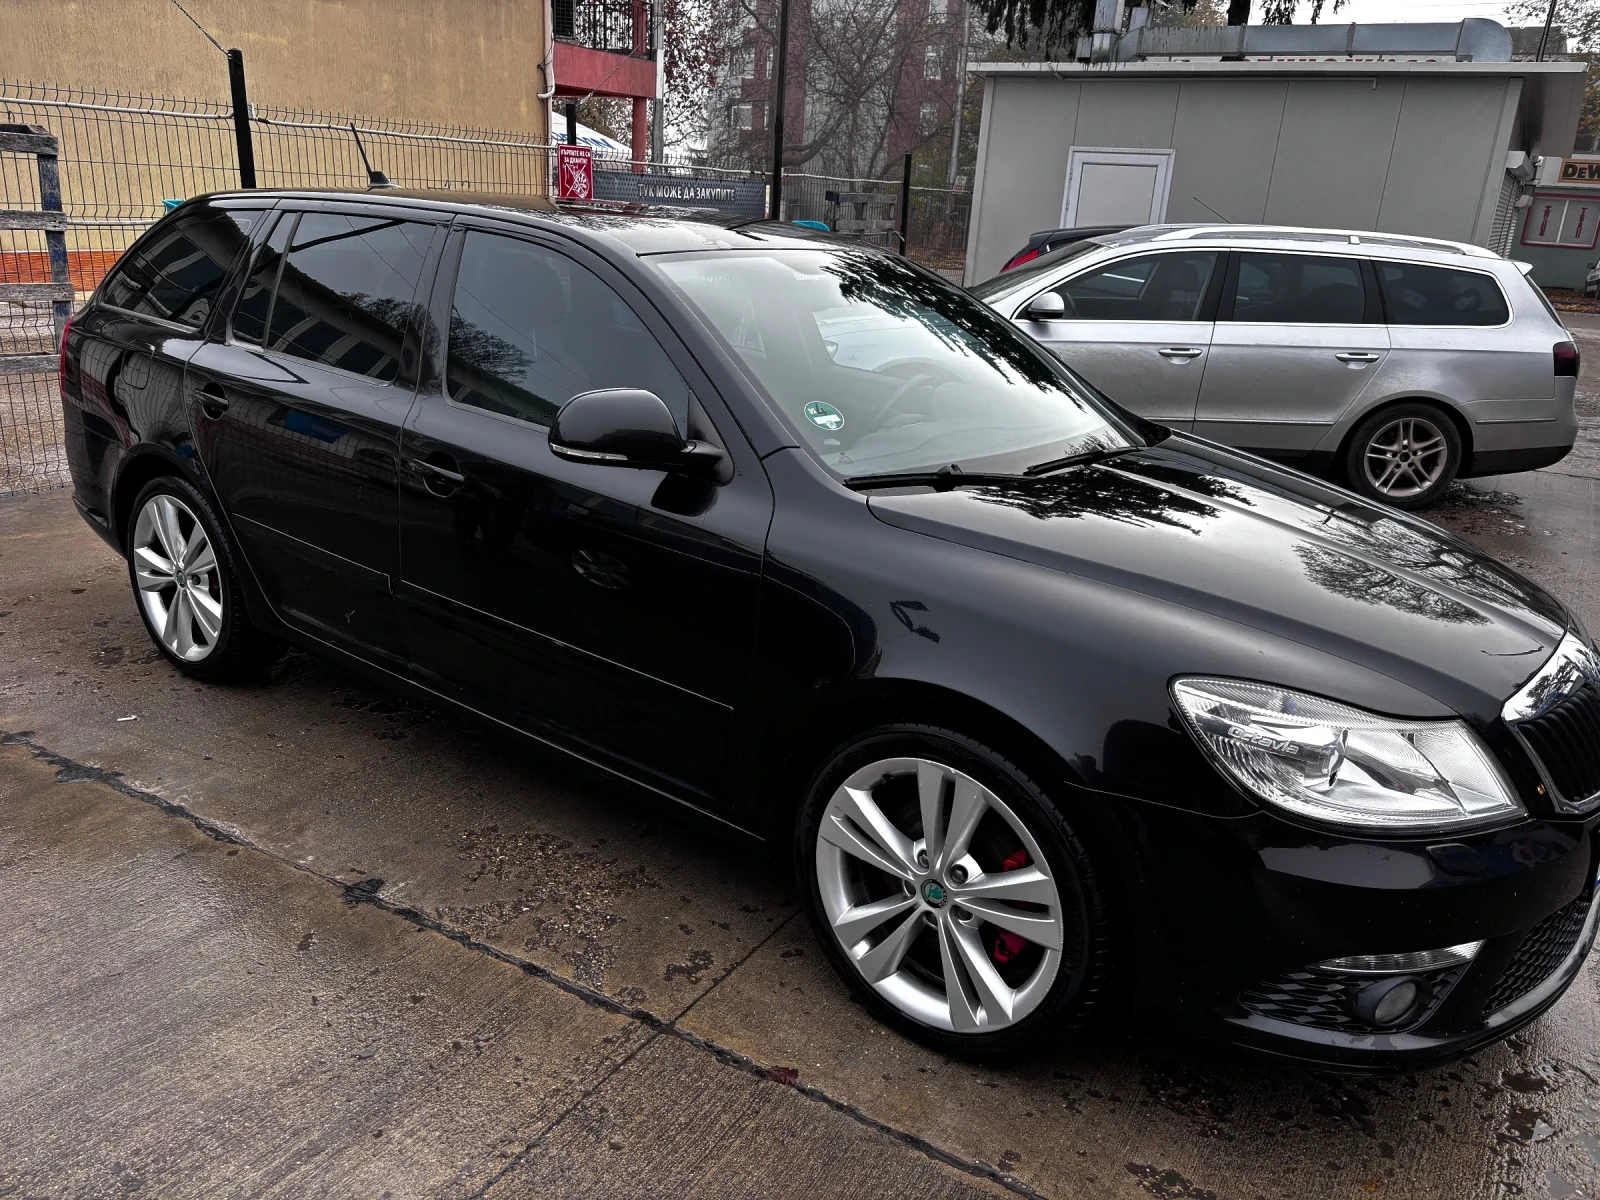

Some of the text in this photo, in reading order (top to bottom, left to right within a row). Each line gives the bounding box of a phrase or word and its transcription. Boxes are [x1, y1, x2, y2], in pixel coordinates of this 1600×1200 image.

[638, 184, 735, 201] ТУК МОЖЕ ДА ЗАКУПИТЕ
